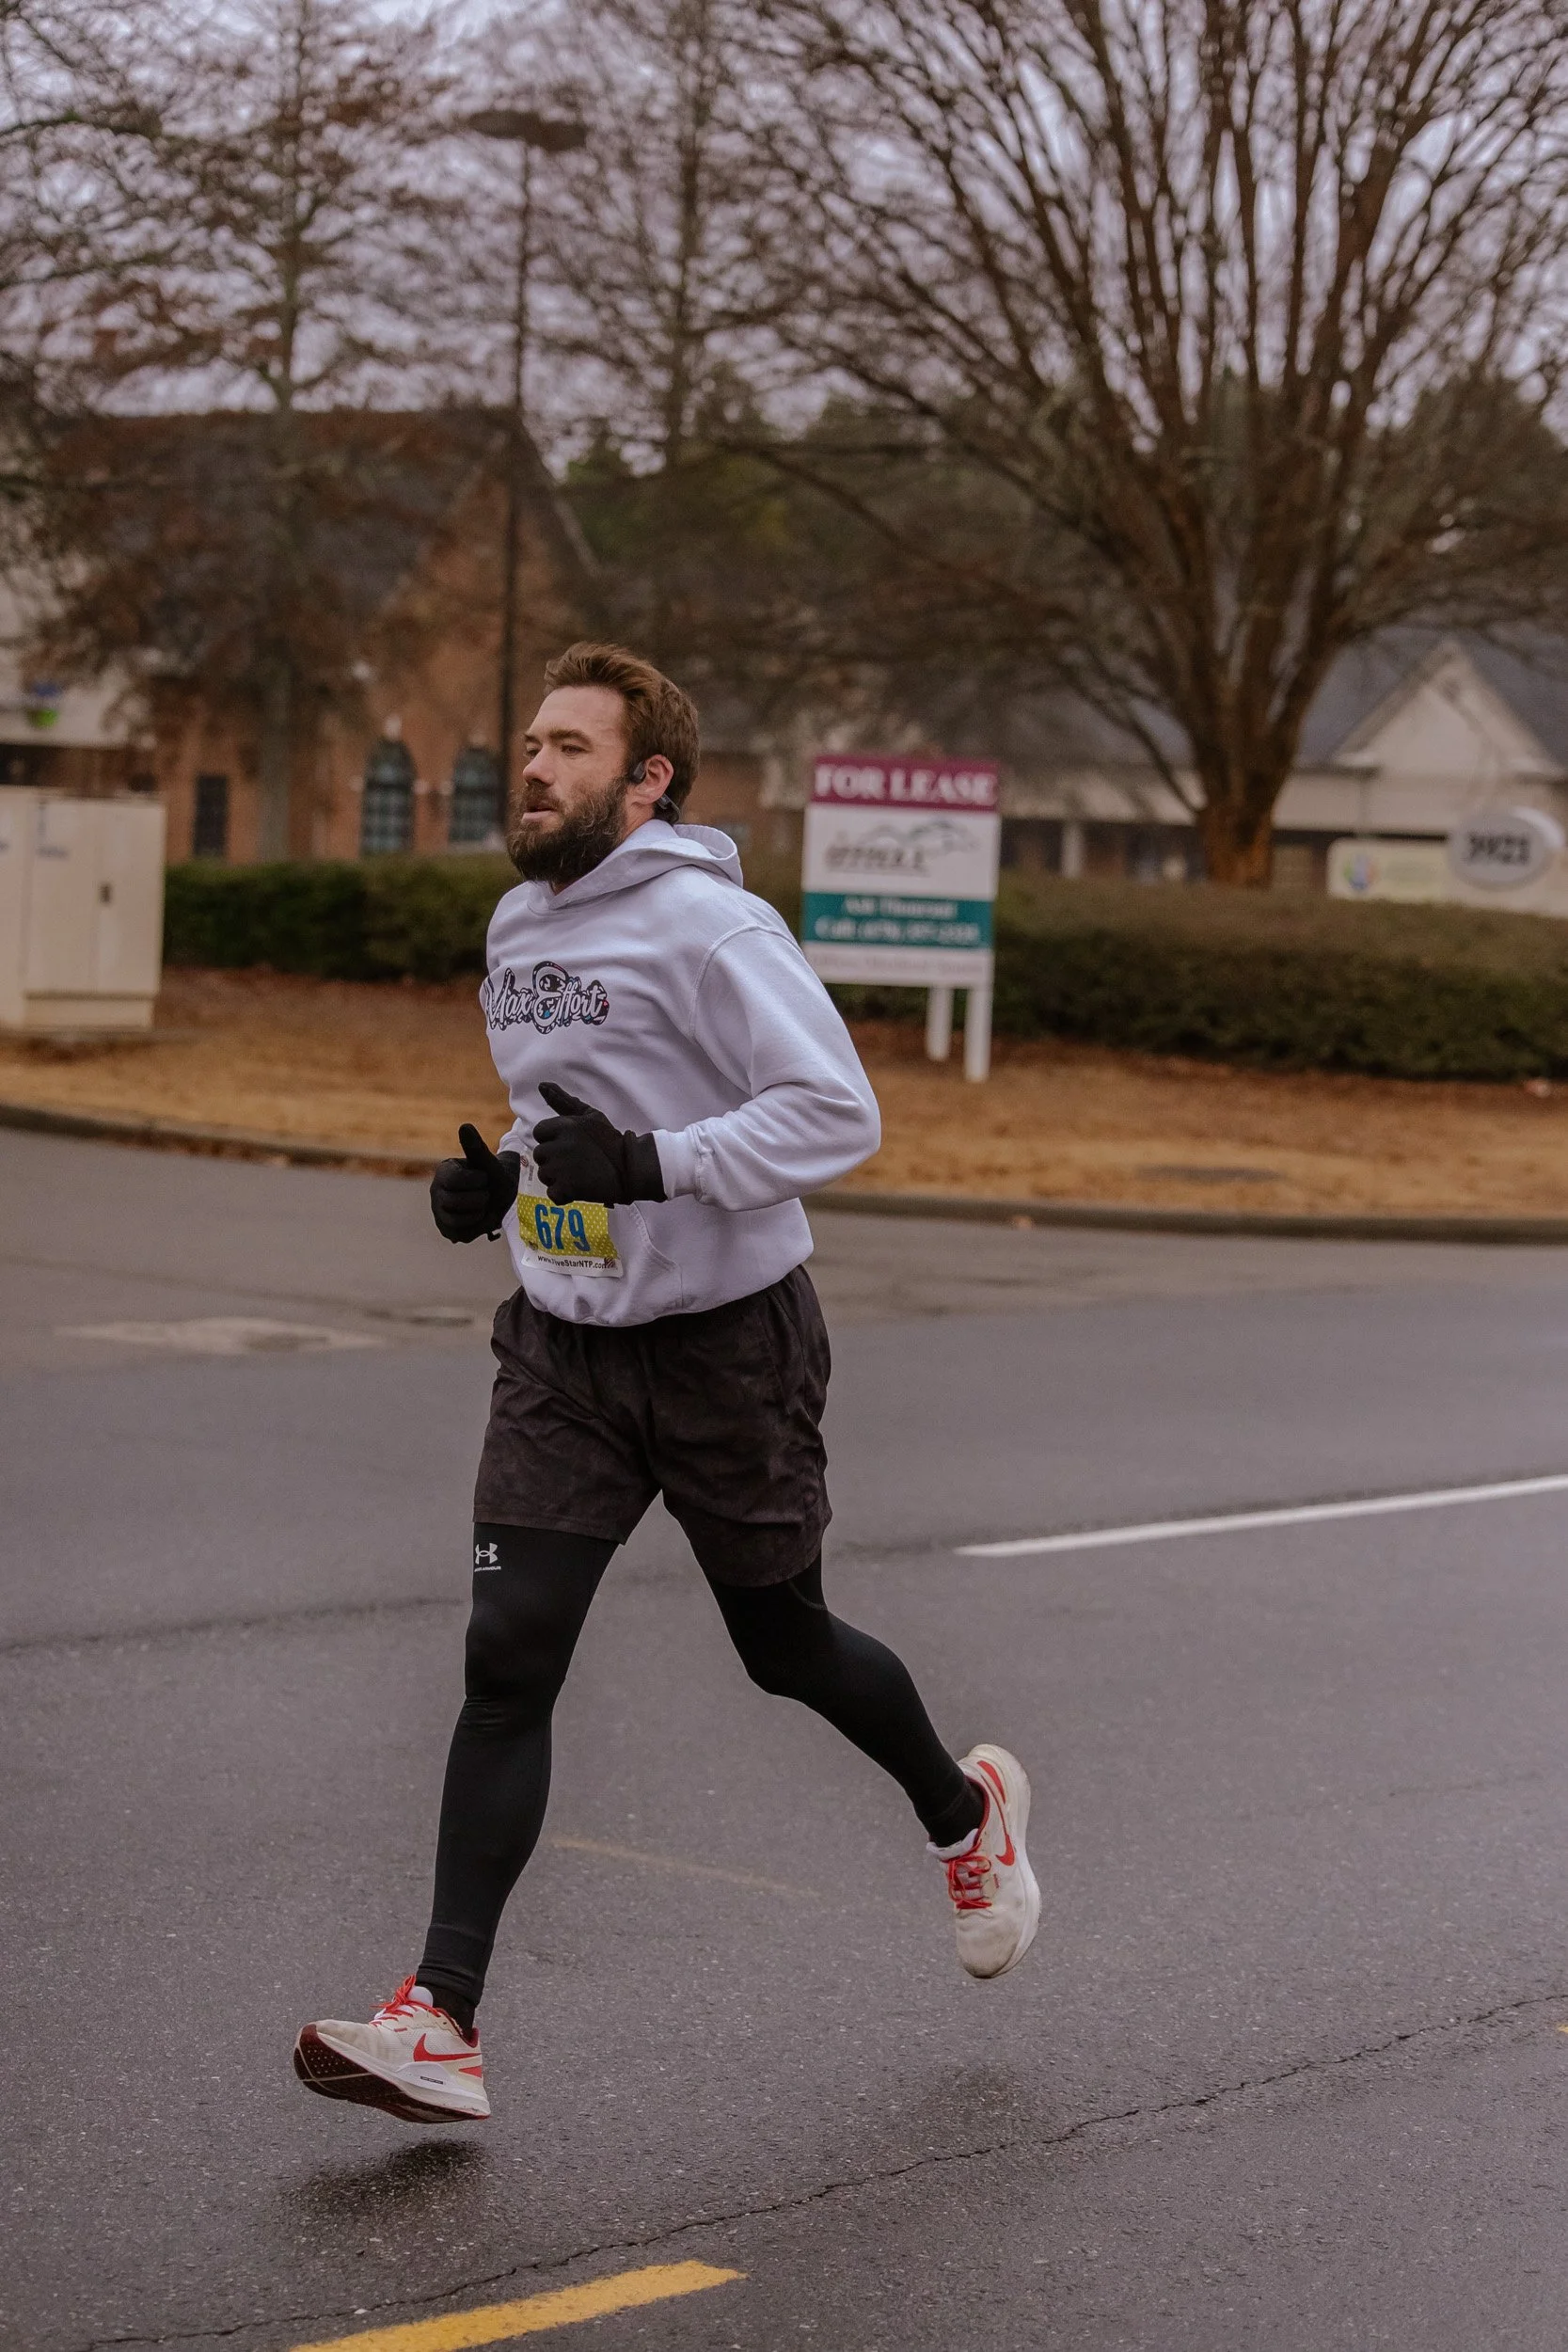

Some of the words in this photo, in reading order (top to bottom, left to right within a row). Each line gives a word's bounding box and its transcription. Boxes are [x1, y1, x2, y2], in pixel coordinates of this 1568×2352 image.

[815, 764, 886, 800] FOR
[891, 770, 996, 805] LEASE
[486, 967, 533, 1030] Max
[532, 961, 610, 1034] Effort
[534, 1203, 591, 1251] 679
